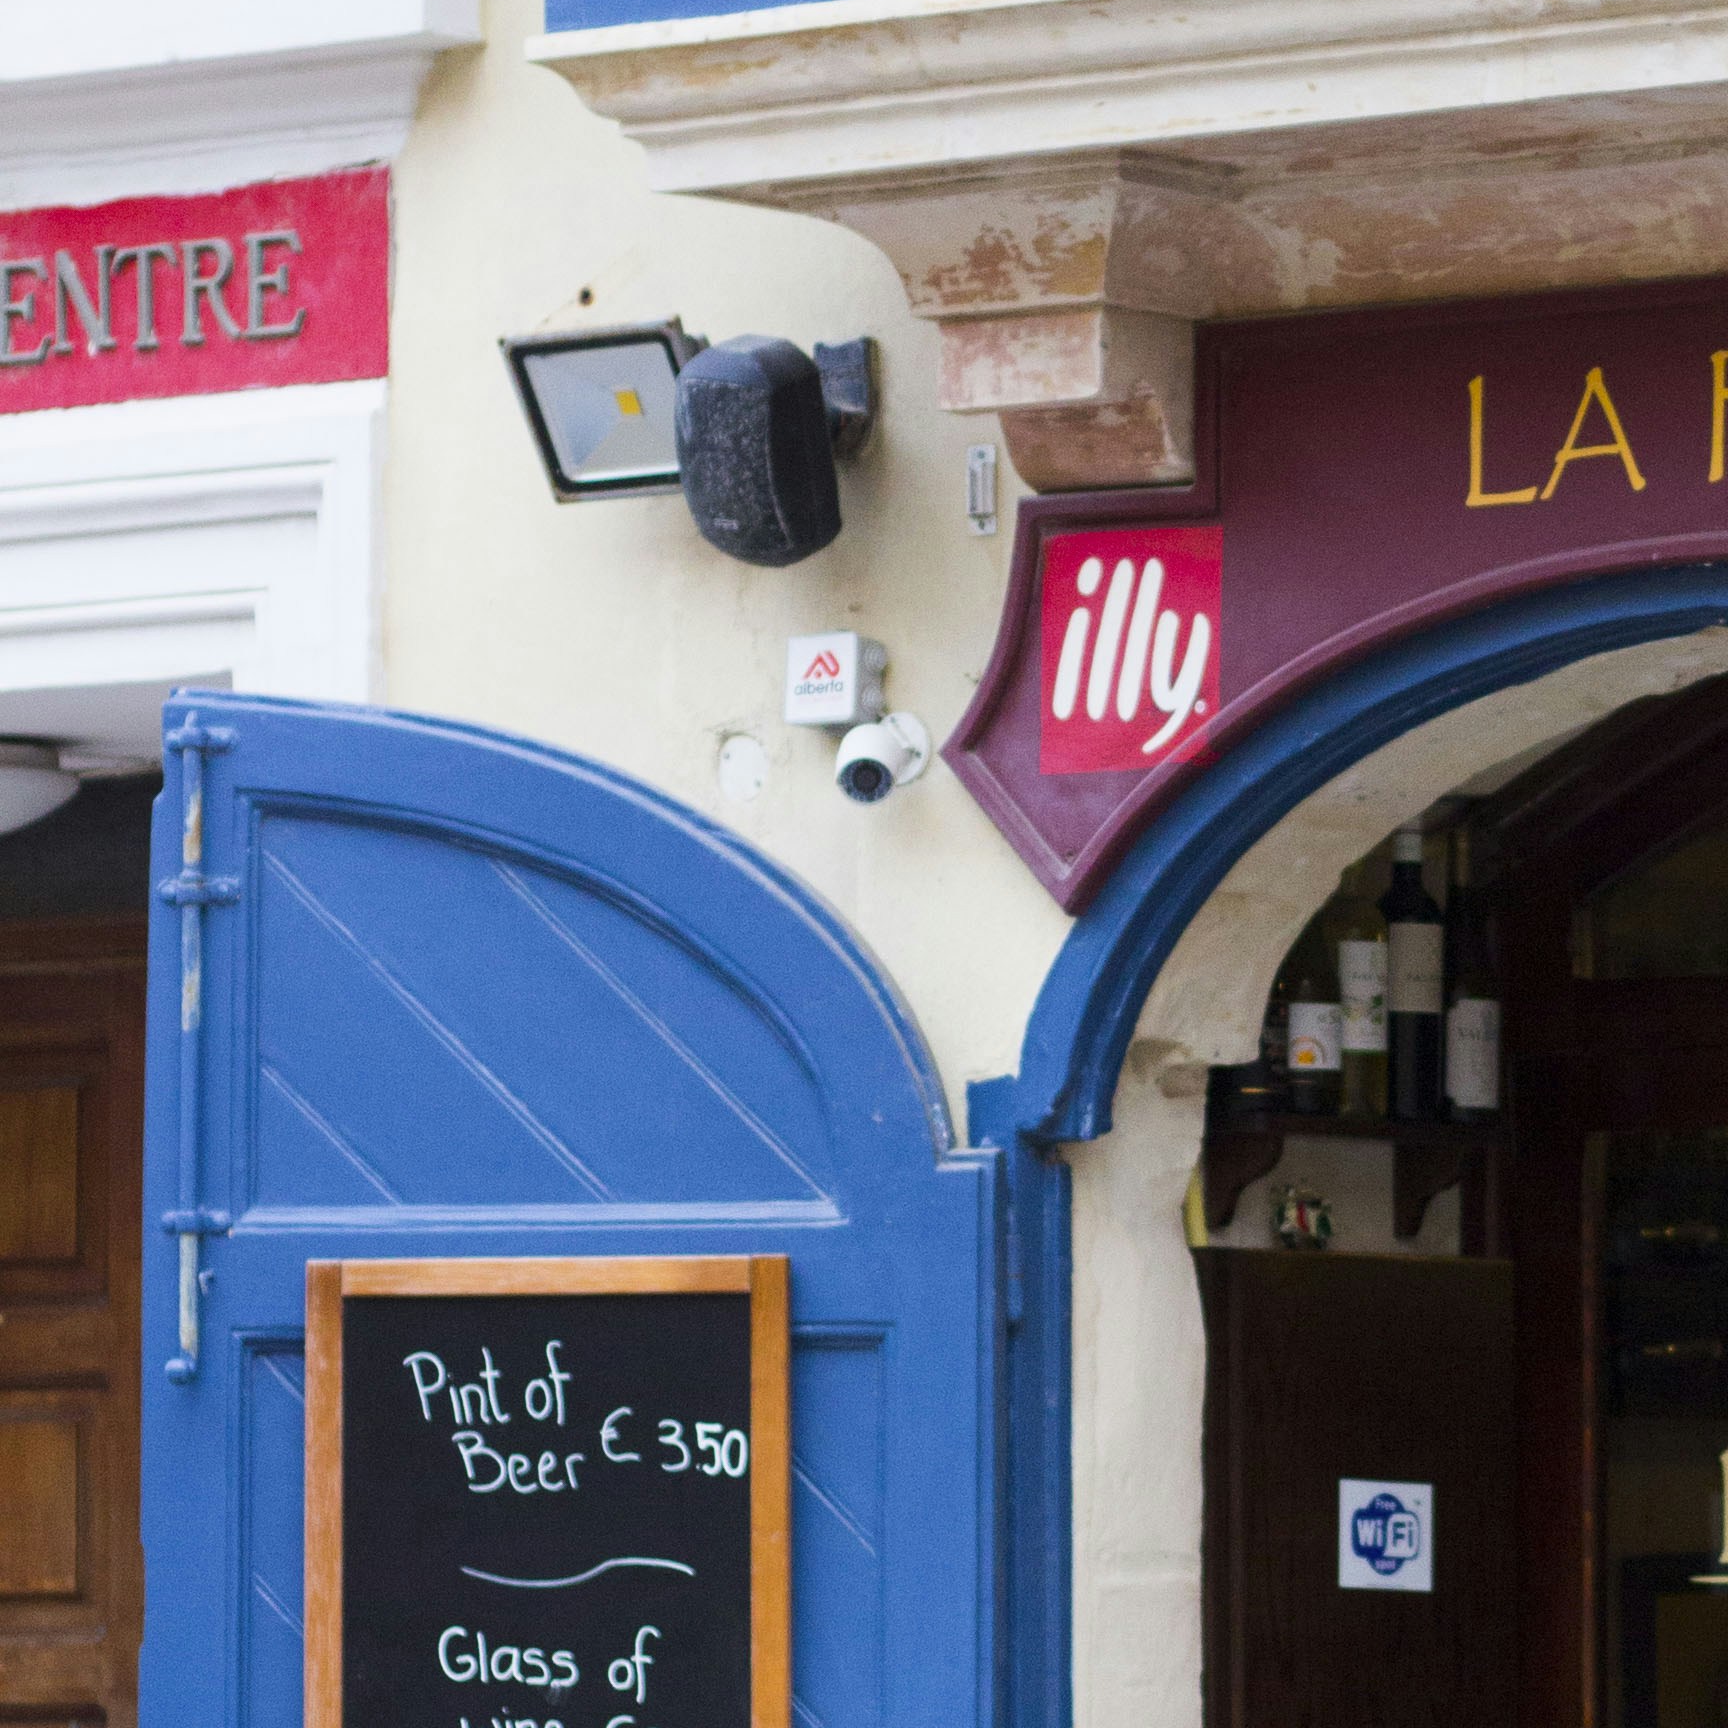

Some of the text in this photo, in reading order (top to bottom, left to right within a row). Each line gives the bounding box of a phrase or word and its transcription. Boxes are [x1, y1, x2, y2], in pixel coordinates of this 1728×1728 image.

[0, 229, 307, 367] ENTRE
[1466, 366, 1646, 506] LA
[794, 680, 843, 696] alberta
[1052, 557, 1211, 754] illy
[402, 1340, 572, 1426] Pint of
[452, 1431, 585, 1493] Beer
[438, 1625, 661, 1703] Glass of
